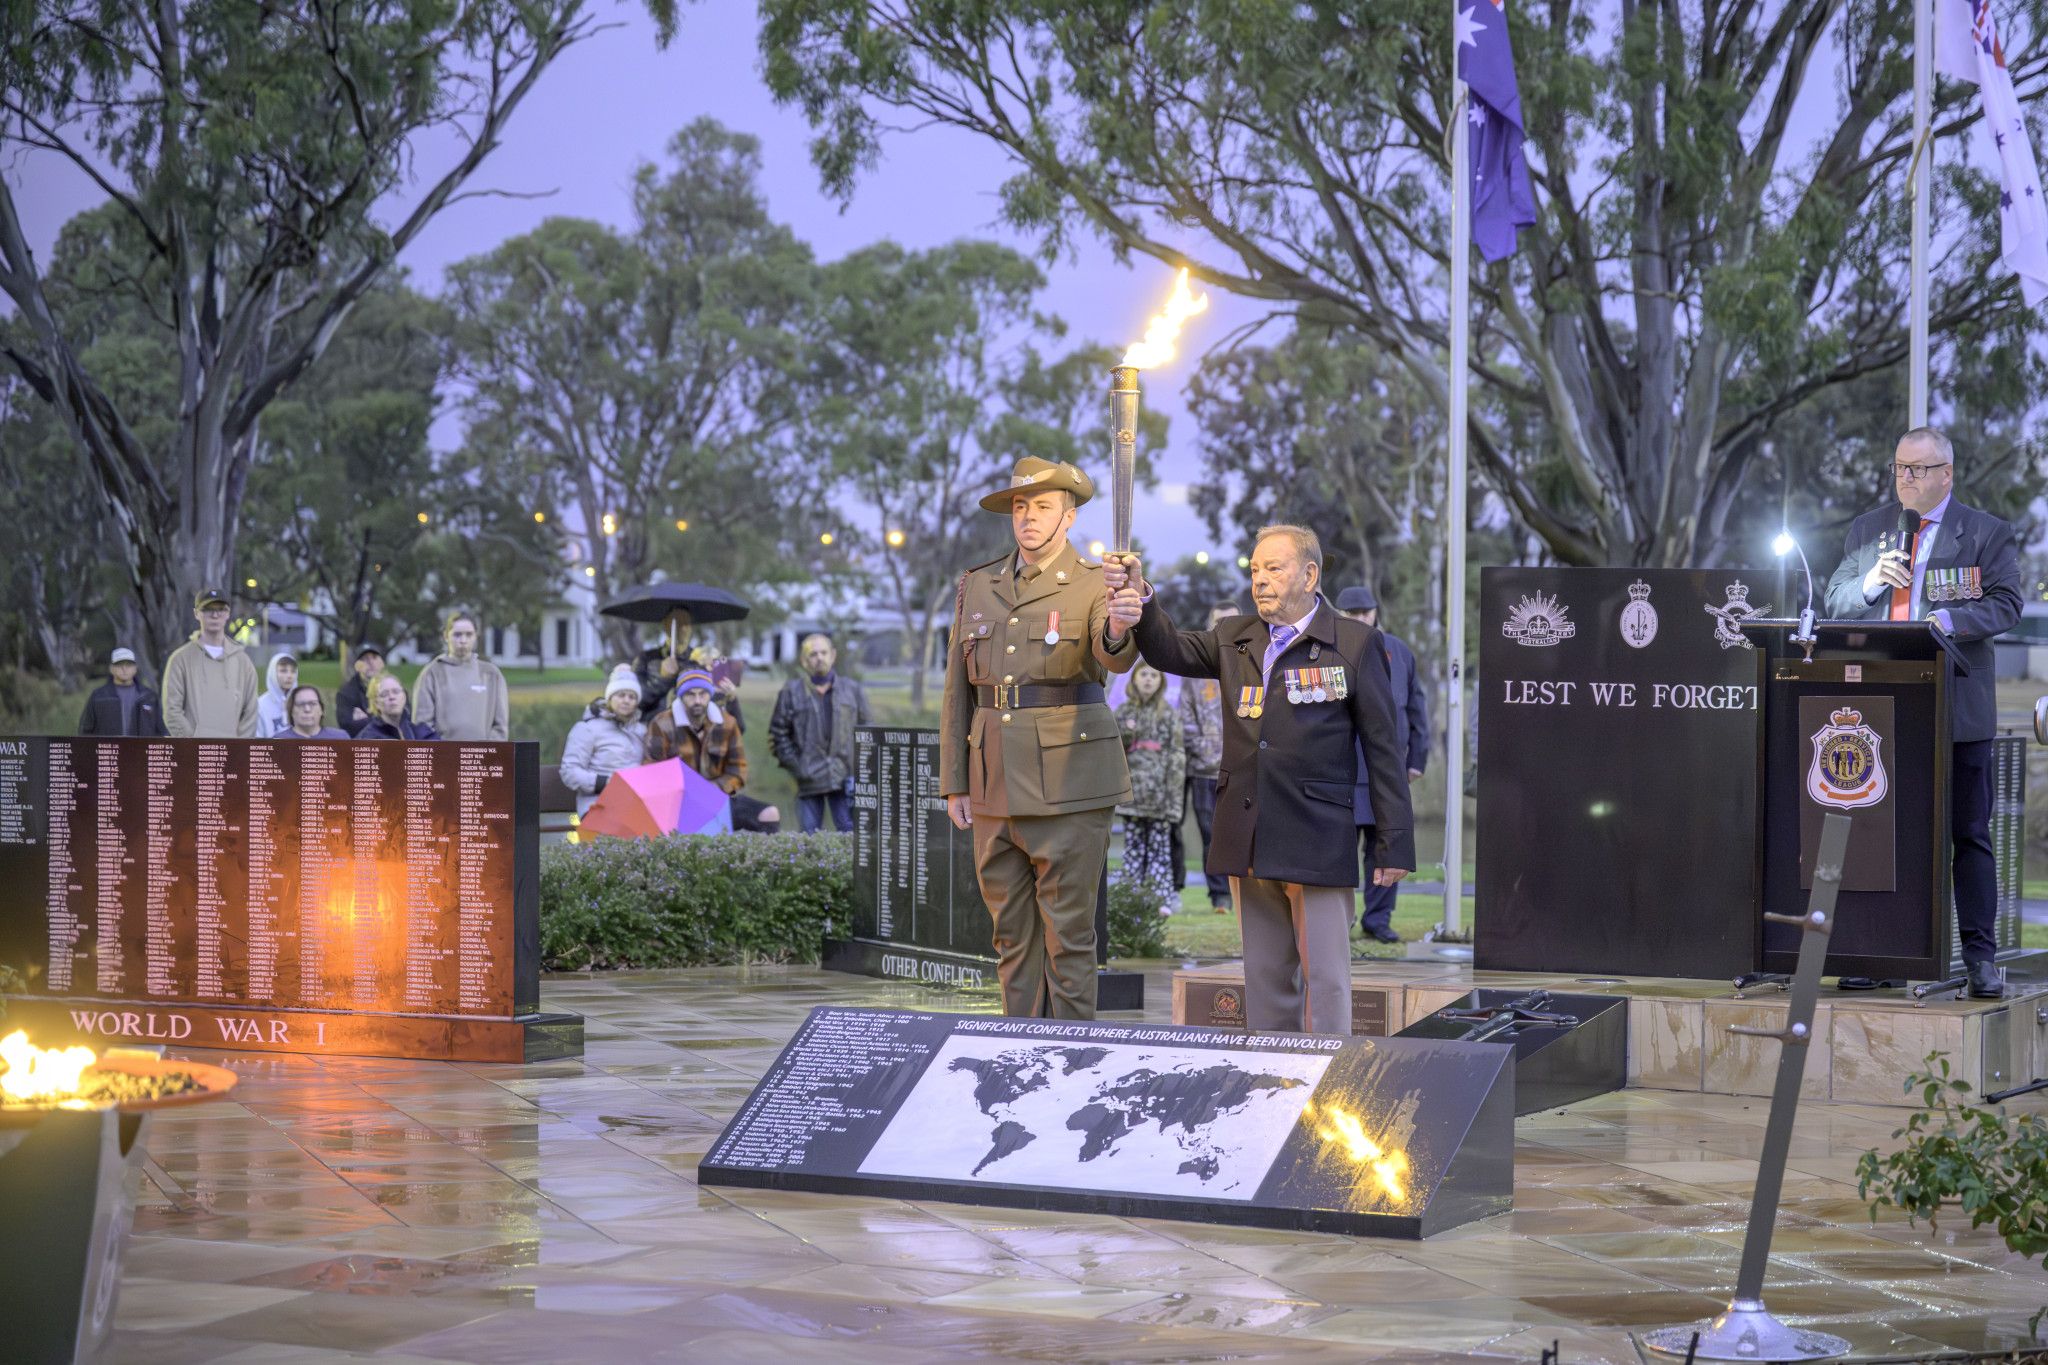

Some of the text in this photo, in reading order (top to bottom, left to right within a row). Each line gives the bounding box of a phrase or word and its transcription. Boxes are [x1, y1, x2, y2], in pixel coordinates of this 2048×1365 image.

[1504, 680, 1757, 710] LEST WE FORGET
[885, 732, 910, 744] VIETNAM
[0, 742, 28, 755] WAR
[917, 764, 931, 777] IRAQ
[855, 783, 877, 796] MALAYA
[1834, 780, 1862, 788] LEAGUE
[855, 796, 877, 809] BORNEO
[917, 797, 930, 810] EAST
[882, 954, 983, 989] OTHER CONFLICTS
[70, 1011, 327, 1046] WORLD WAR I
[955, 1020, 1342, 1050] SIGNIFICANT CONFLICTS WHERE AUSTRALIANS HAVE BEEN INVOLVED
